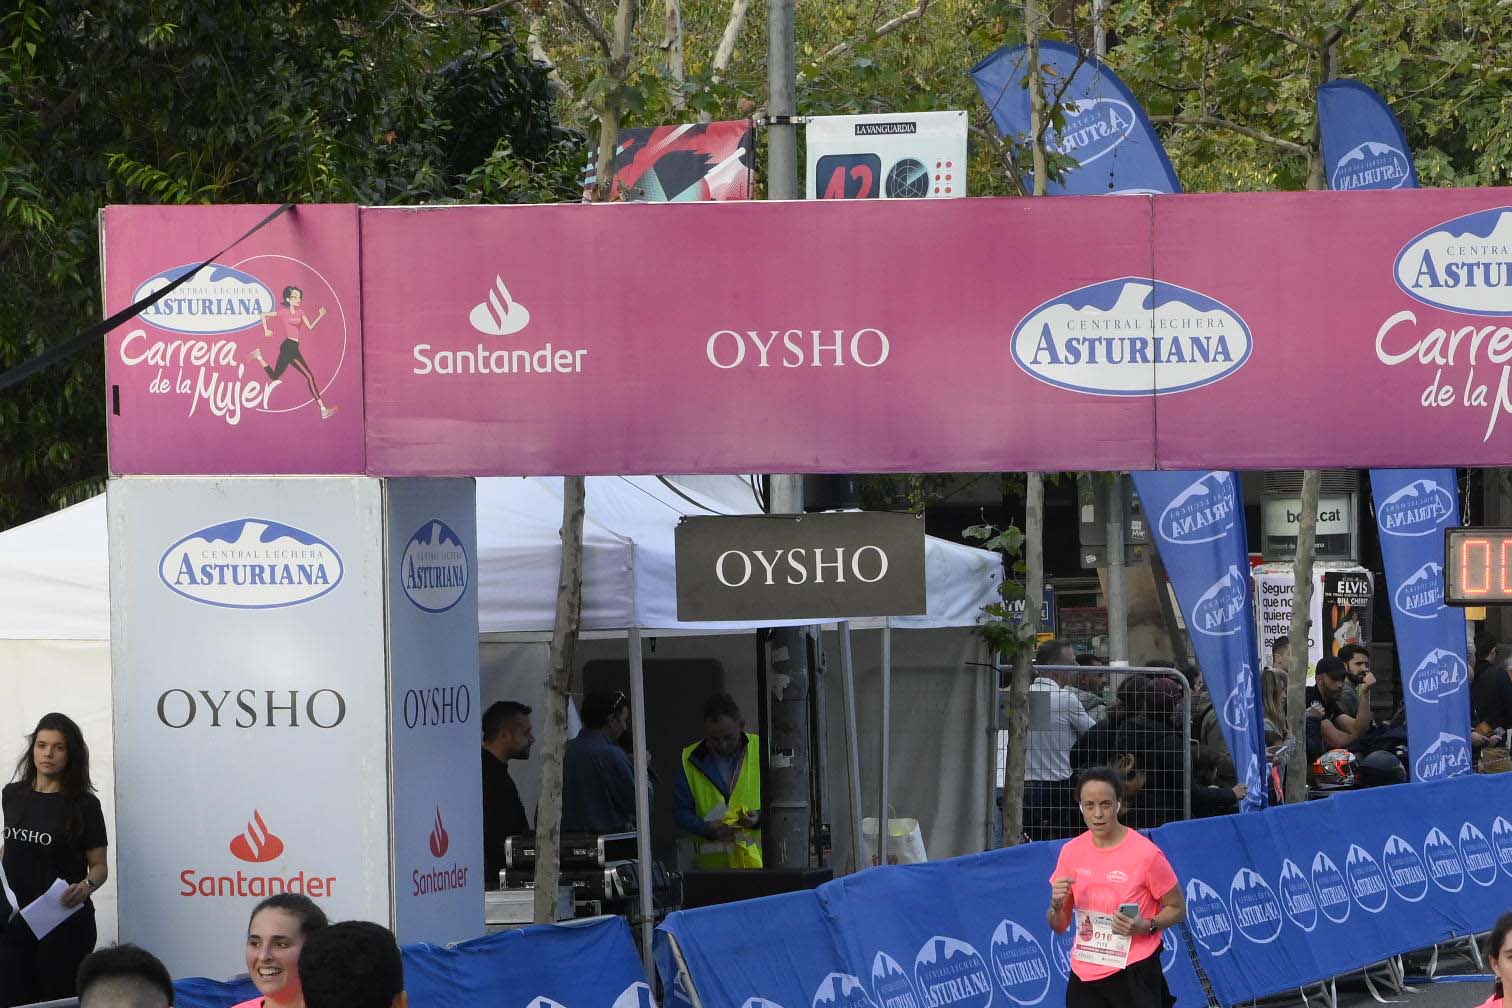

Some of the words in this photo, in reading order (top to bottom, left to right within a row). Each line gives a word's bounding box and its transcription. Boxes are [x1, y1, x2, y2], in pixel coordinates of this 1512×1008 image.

[171, 287, 209, 295] ENTRAL
[214, 287, 259, 295] LECHERA
[1067, 319, 1141, 330] CENTRAL
[1150, 318, 1225, 329] LECHERA
[120, 329, 237, 367] Carrera
[413, 342, 587, 375] Santander
[706, 327, 890, 370] OYSHO
[1030, 322, 1234, 365] ASTURIANA
[150, 369, 170, 393] de
[176, 369, 191, 393] la
[189, 363, 282, 424] Mujer
[1421, 368, 1455, 407] de
[1463, 368, 1487, 407] la
[174, 552, 330, 585] ASTURIANA
[201, 550, 258, 559] CENTRAL
[265, 550, 323, 559] LECHERA
[406, 553, 465, 590] ASTURIANA
[716, 545, 889, 587] OYSHO
[1263, 598, 1278, 609] que
[1338, 581, 1367, 594] ELVIS
[157, 688, 347, 729] OYSHO
[403, 684, 470, 729] OYSHO
[180, 870, 336, 897] Santander
[413, 863, 468, 897] Santander
